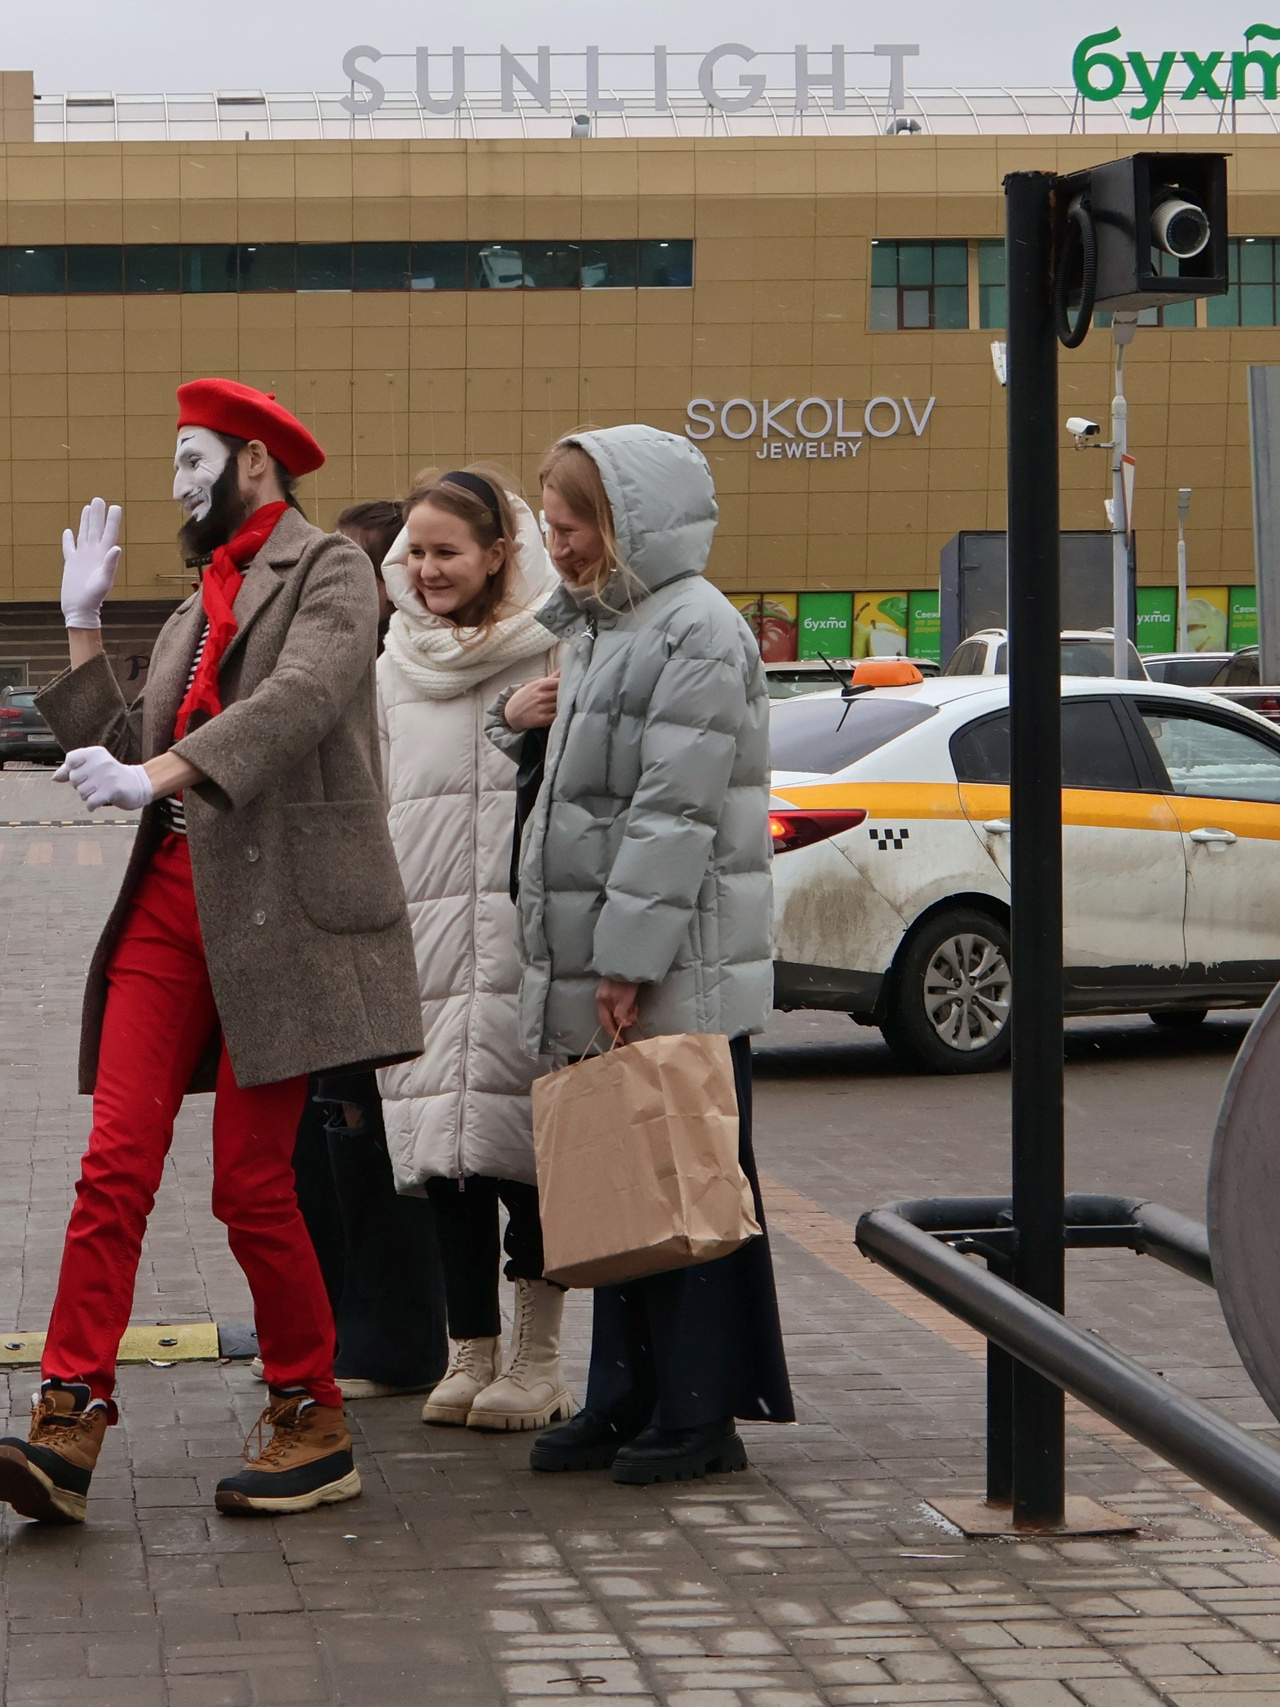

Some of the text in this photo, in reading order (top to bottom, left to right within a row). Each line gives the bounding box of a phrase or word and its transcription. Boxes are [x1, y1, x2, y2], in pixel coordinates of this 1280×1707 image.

[340, 43, 920, 115] SUNLIGHT
[685, 397, 936, 440] SOKOLOV
[757, 442, 862, 458] JEWELRY
[804, 617, 847, 632] бухта
[1136, 611, 1171, 625] ухта
